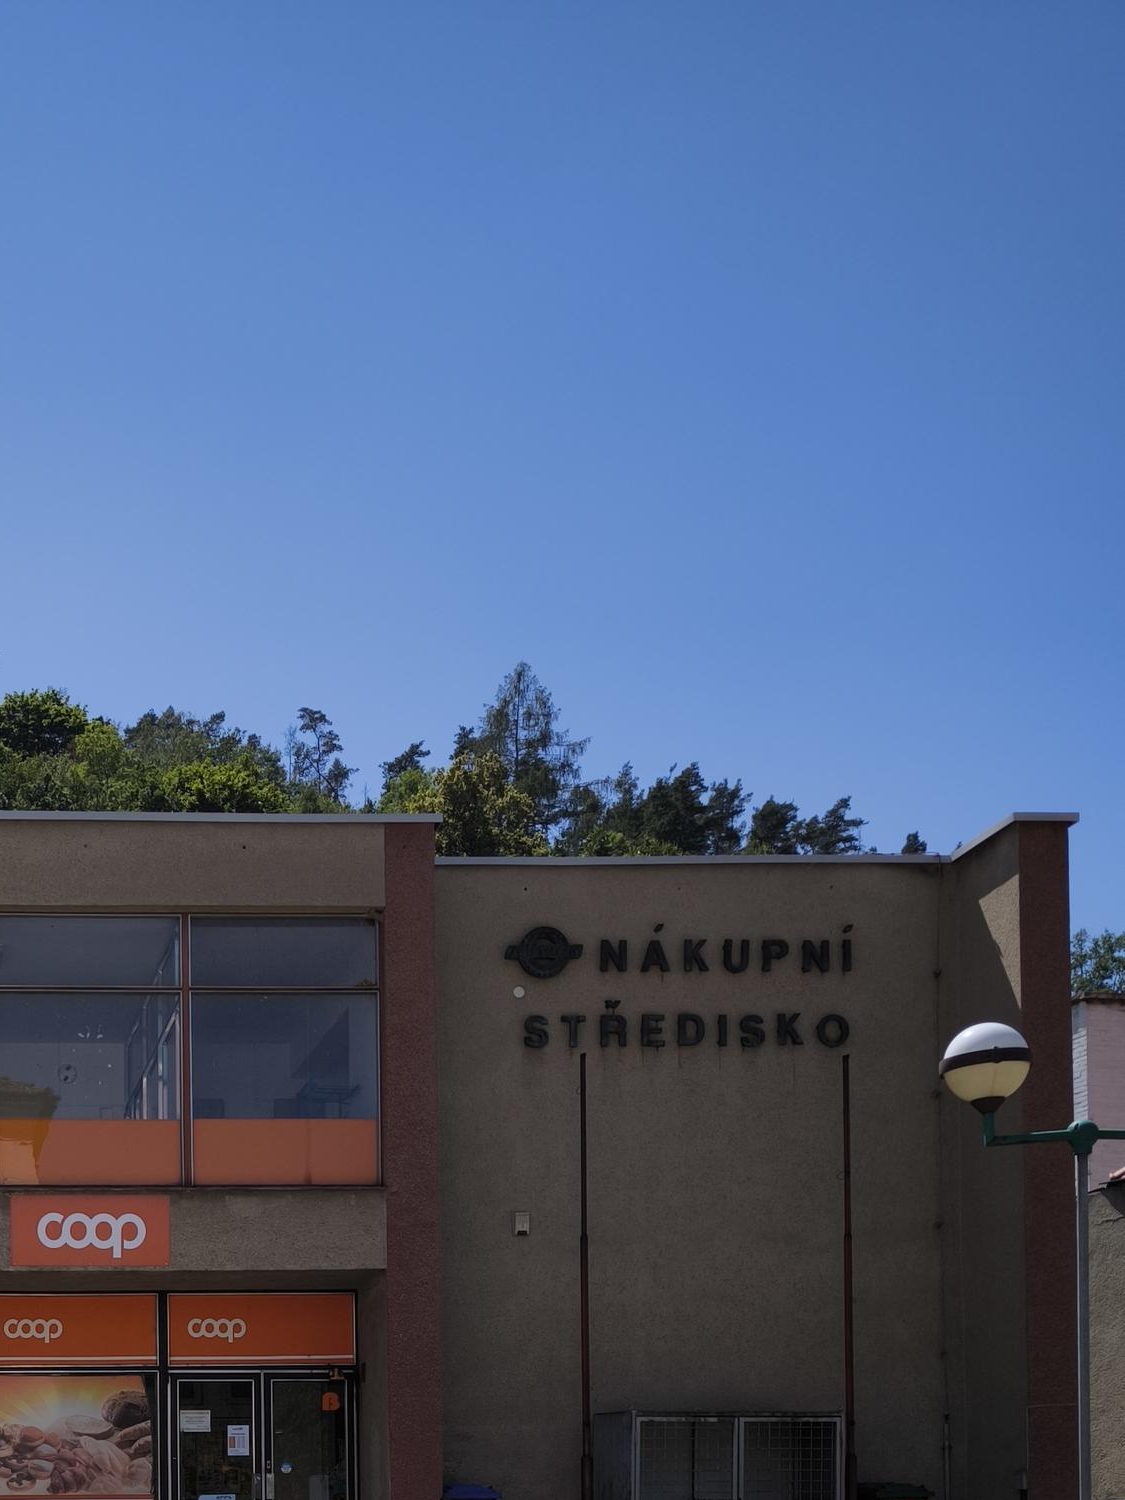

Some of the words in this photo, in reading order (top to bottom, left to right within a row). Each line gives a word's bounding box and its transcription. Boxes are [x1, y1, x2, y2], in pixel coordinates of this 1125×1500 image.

[599, 923, 854, 974] NÁKUPNÍ
[523, 1000, 851, 1048] STŘEDISKO
[37, 1212, 147, 1259] coop
[3, 1318, 63, 1344] coop
[187, 1318, 247, 1343] coop
